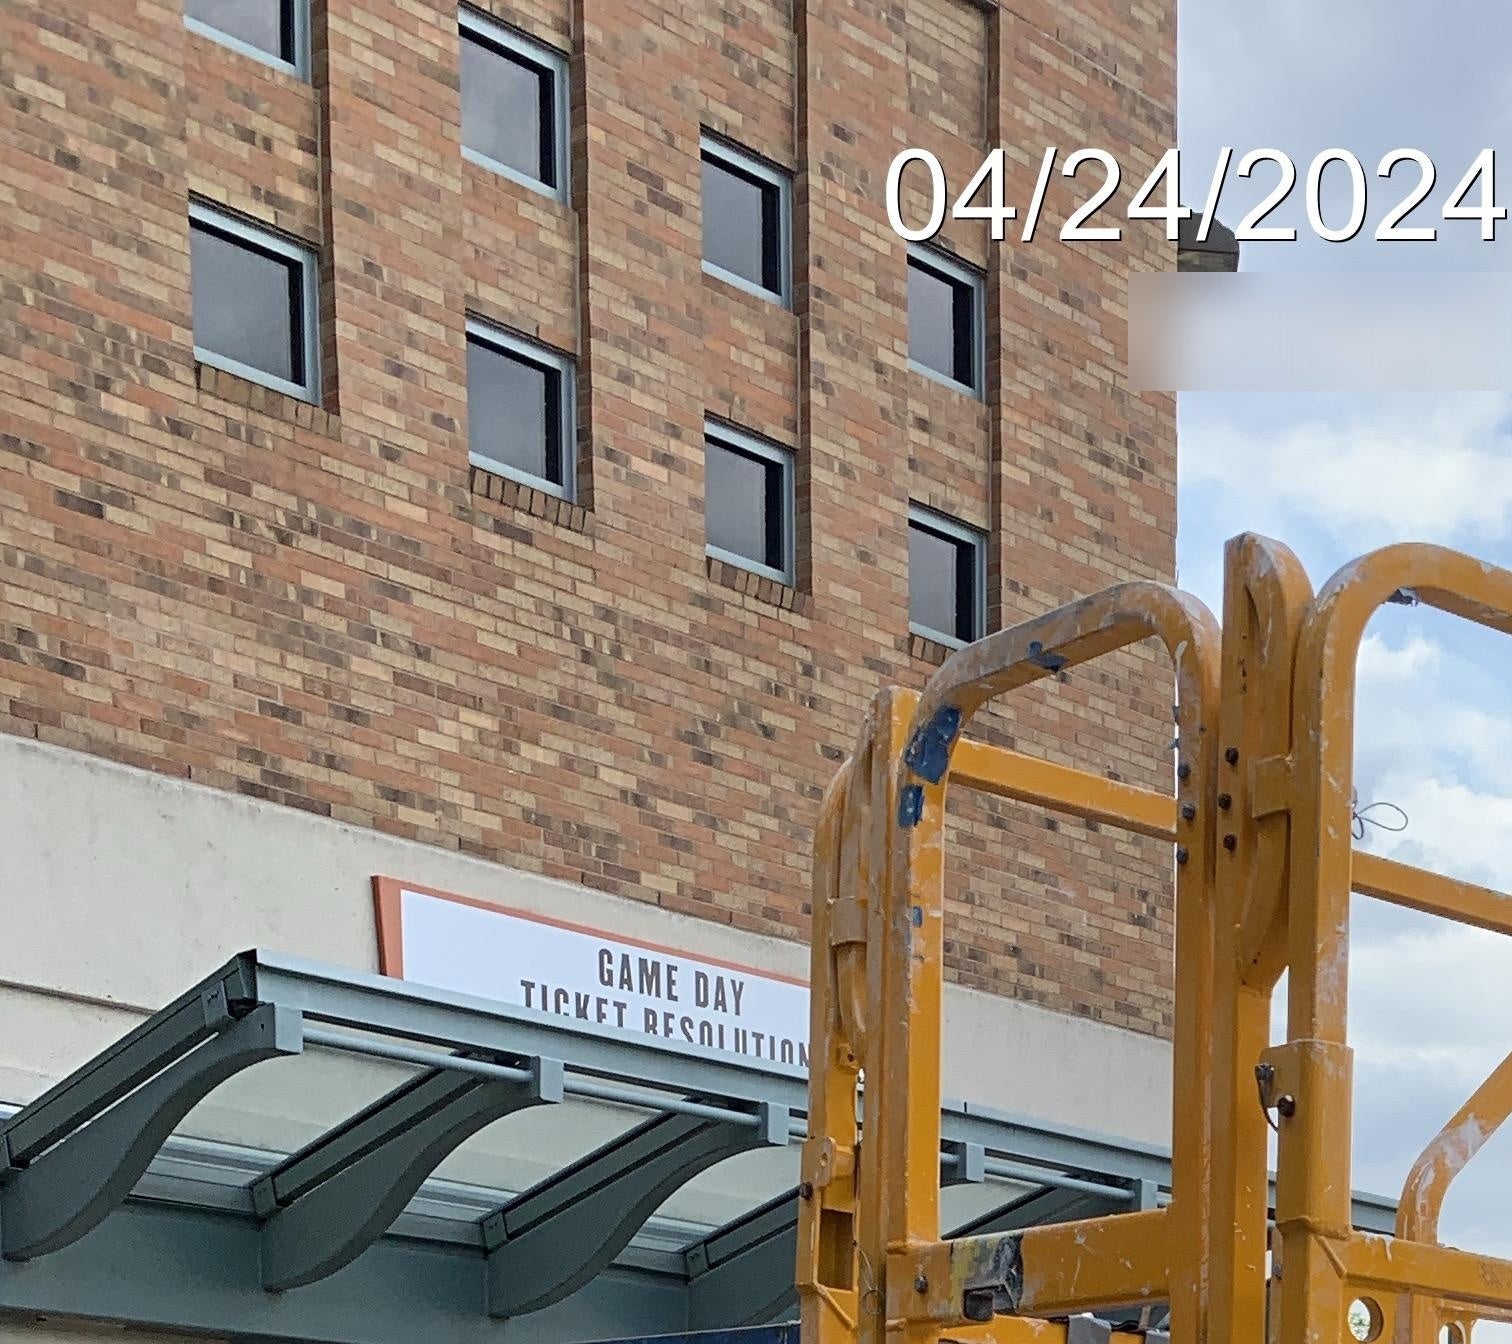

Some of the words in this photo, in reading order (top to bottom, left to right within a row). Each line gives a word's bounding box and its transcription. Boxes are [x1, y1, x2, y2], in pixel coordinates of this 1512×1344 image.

[520, 979, 627, 1029] TICKET
[598, 947, 678, 1002] GAME
[694, 970, 745, 1017] DAY
